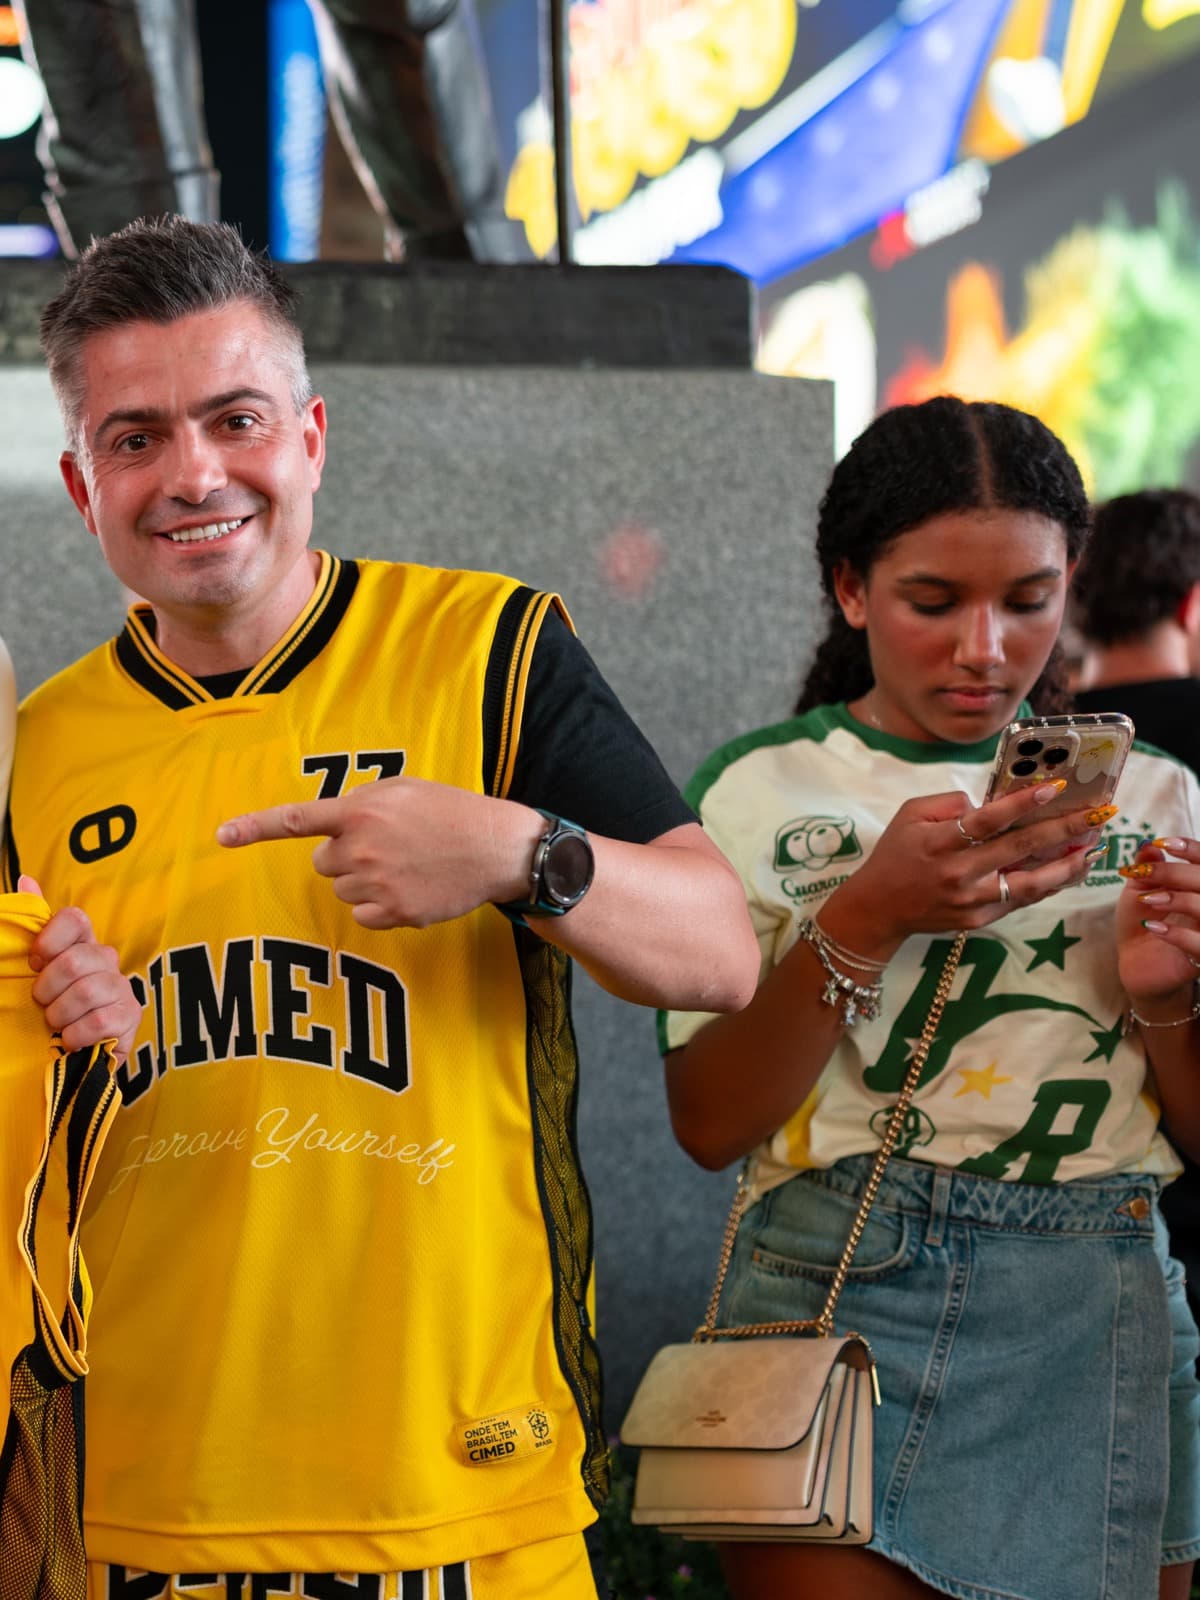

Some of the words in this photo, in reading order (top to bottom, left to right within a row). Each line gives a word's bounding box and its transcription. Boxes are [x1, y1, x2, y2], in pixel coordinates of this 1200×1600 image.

[250, 1107, 456, 1186] Yourself
[464, 1425, 491, 1439] ONDE
[492, 1420, 511, 1432] TEM
[469, 1441, 516, 1462] CIMED
